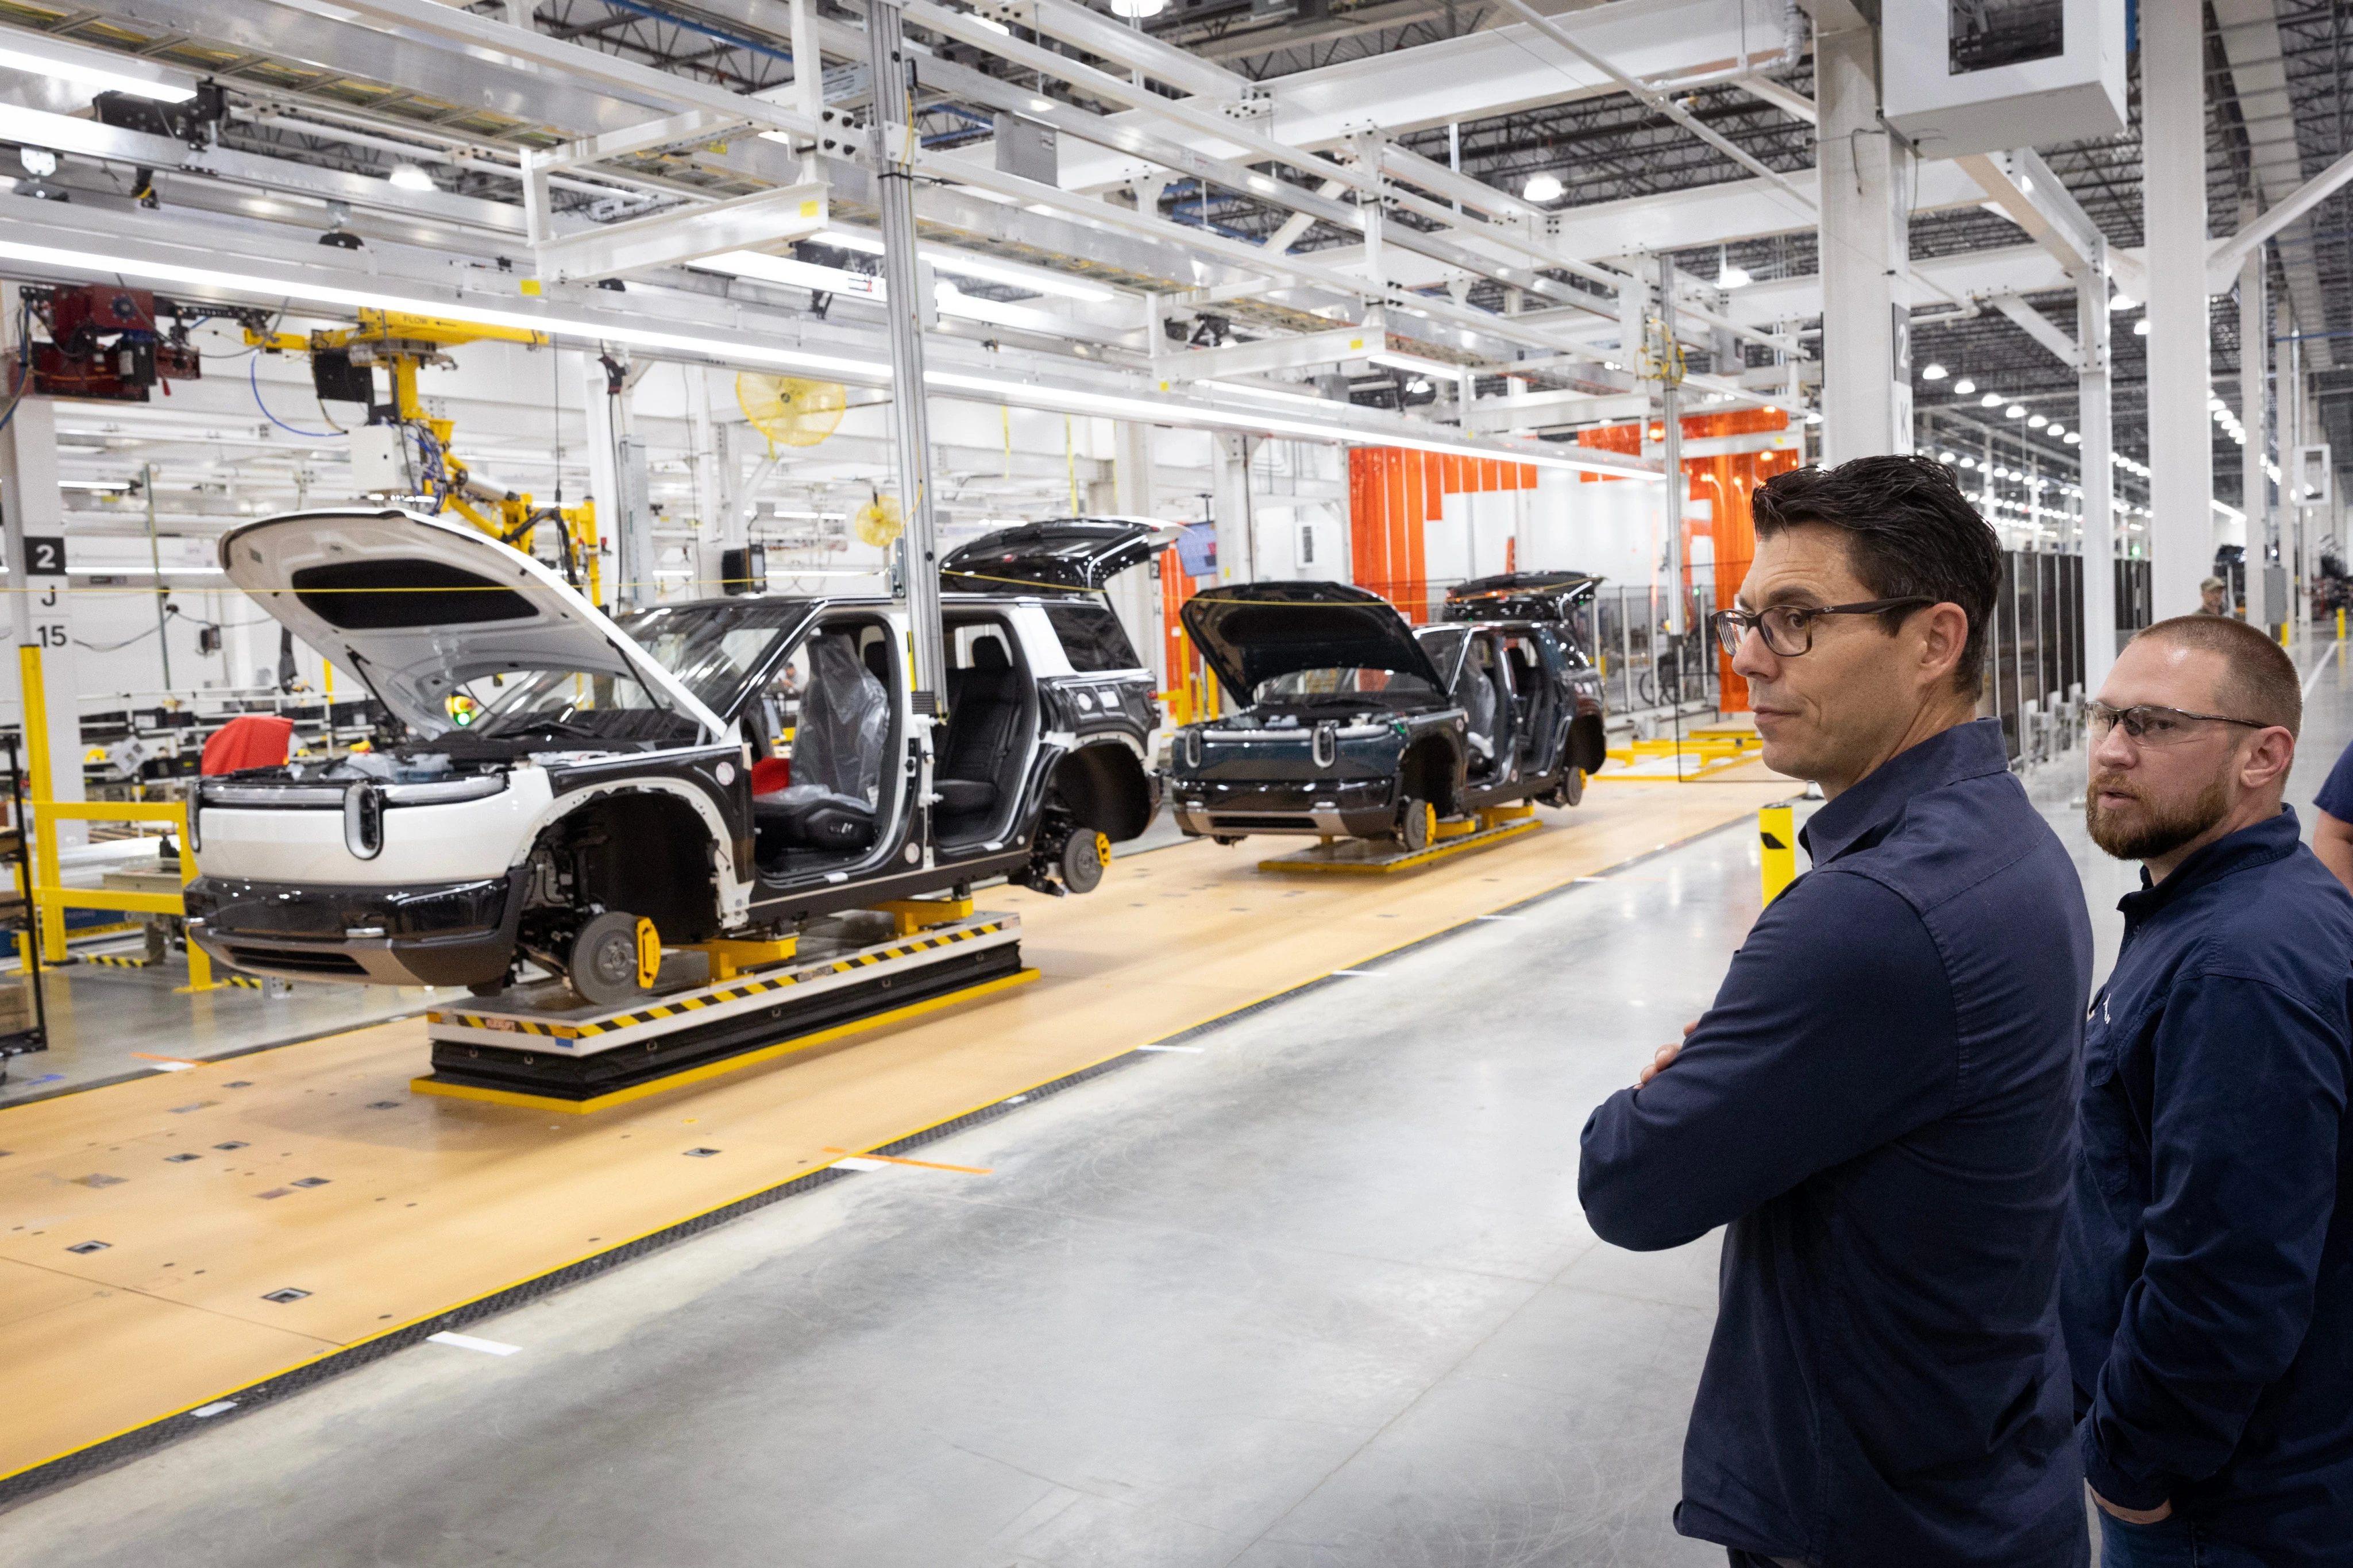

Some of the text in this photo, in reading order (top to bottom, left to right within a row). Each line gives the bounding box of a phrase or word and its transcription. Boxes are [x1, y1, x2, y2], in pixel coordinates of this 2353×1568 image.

[403, 315, 427, 324] FLOW
[1898, 323, 1908, 369] 2
[1900, 400, 1910, 445] K
[36, 544, 56, 569] 2
[1151, 563, 1159, 577] 2
[41, 584, 56, 607] J
[37, 625, 67, 648] 15
